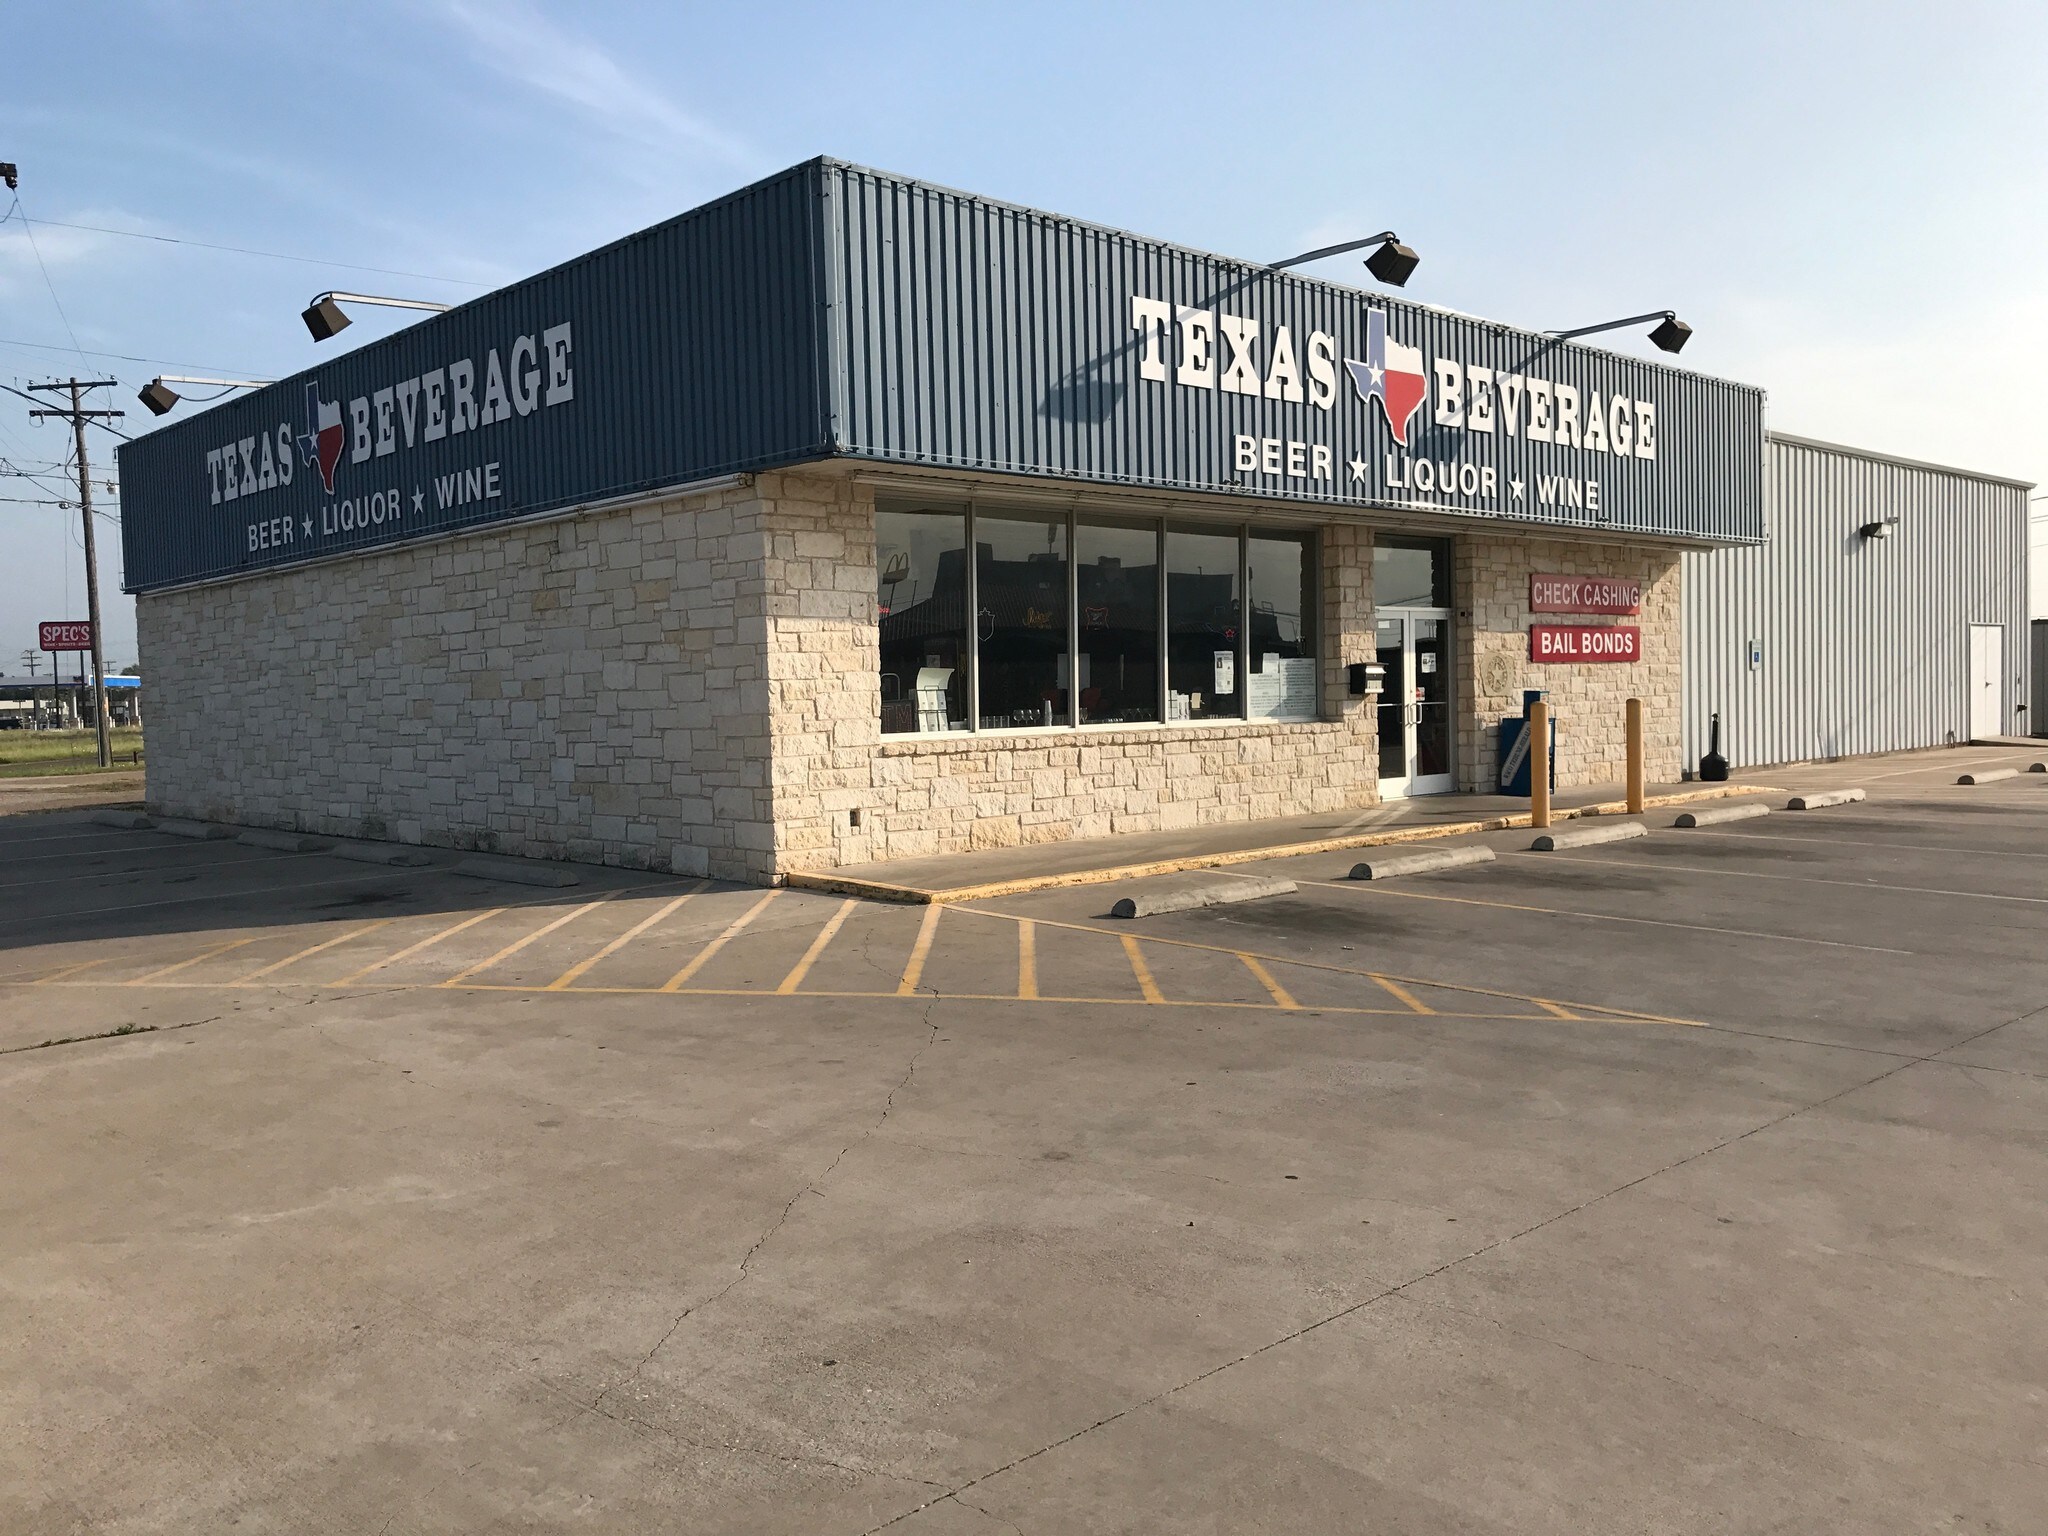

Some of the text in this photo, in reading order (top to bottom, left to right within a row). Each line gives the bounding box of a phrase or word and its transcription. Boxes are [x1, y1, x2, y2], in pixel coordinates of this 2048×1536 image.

[206, 321, 574, 505] TEXAS BEVERAGE
[1131, 296, 1656, 460] TEXAS BEVERAGE
[248, 461, 502, 552] BEER LIQUOR WINE
[1234, 434, 1599, 510] BEER LIQUOR WINE
[1533, 582, 1639, 607] CHECK CASHING
[42, 626, 90, 642] SPEC'S
[1541, 633, 1634, 654] BAIL BONDS
